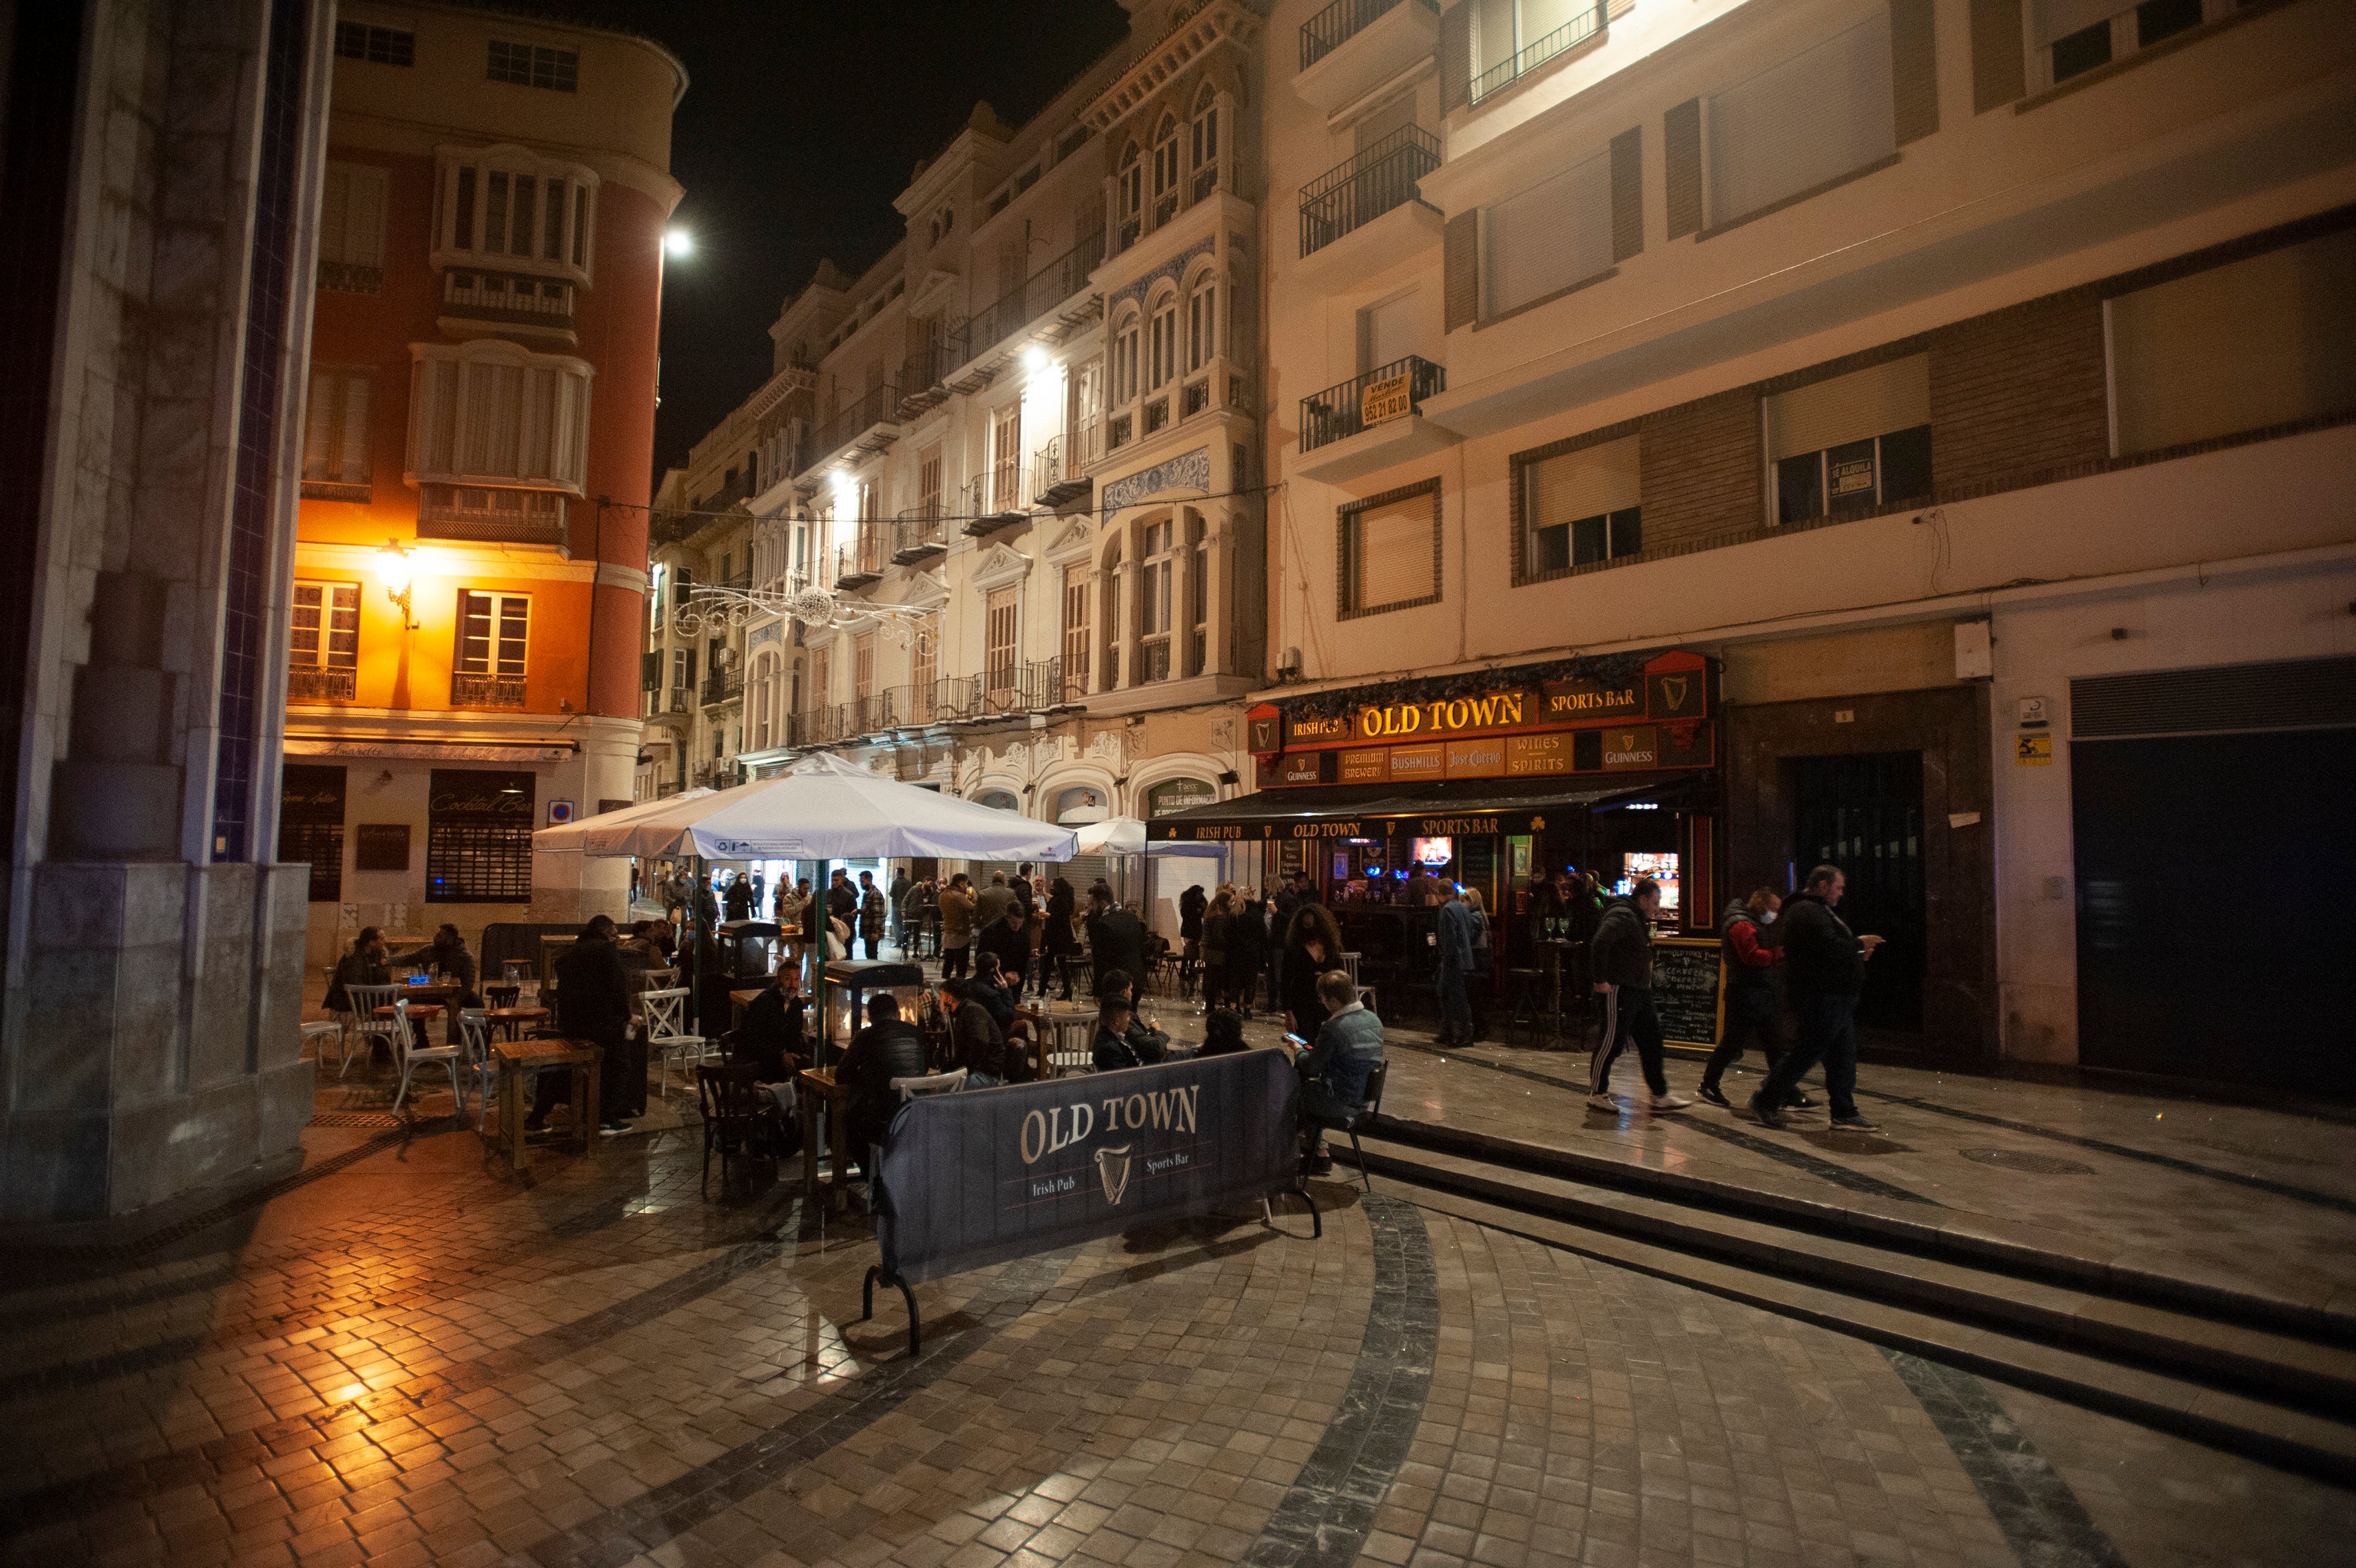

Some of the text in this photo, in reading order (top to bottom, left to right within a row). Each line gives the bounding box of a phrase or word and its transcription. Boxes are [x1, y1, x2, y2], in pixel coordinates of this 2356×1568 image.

[1371, 376, 1405, 393] VENDE
[1832, 462, 1871, 479] SE ALQUILA
[1551, 689, 1635, 712] SPORTS BAR
[1363, 694, 1523, 736] OLD TOWN
[1294, 721, 1318, 736] IRISH
[1517, 736, 1560, 751] WINES
[1345, 752, 1385, 764] PREMIUM
[1391, 755, 1441, 770] BUSHMILLS
[1470, 751, 1501, 765] Cuervo
[1513, 757, 1564, 772] SPIRITS
[1605, 751, 1653, 764] GUINNESS
[1287, 771, 1317, 781] GUINNESS
[1345, 766, 1382, 779] BREWERY
[432, 794, 532, 813] Cocktail Bar
[1158, 795, 1175, 806] PUNTO
[1176, 795, 1182, 805] DE
[1196, 826, 1242, 839] IRISH PUB
[1293, 823, 1361, 838] OLD TOWN
[1422, 819, 1499, 836] SPORTS BAR
[1021, 1085, 1200, 1164] OLD TOWN
[1147, 1153, 1189, 1174] Sports Bar
[1033, 1176, 1075, 1197] Irish Pub
